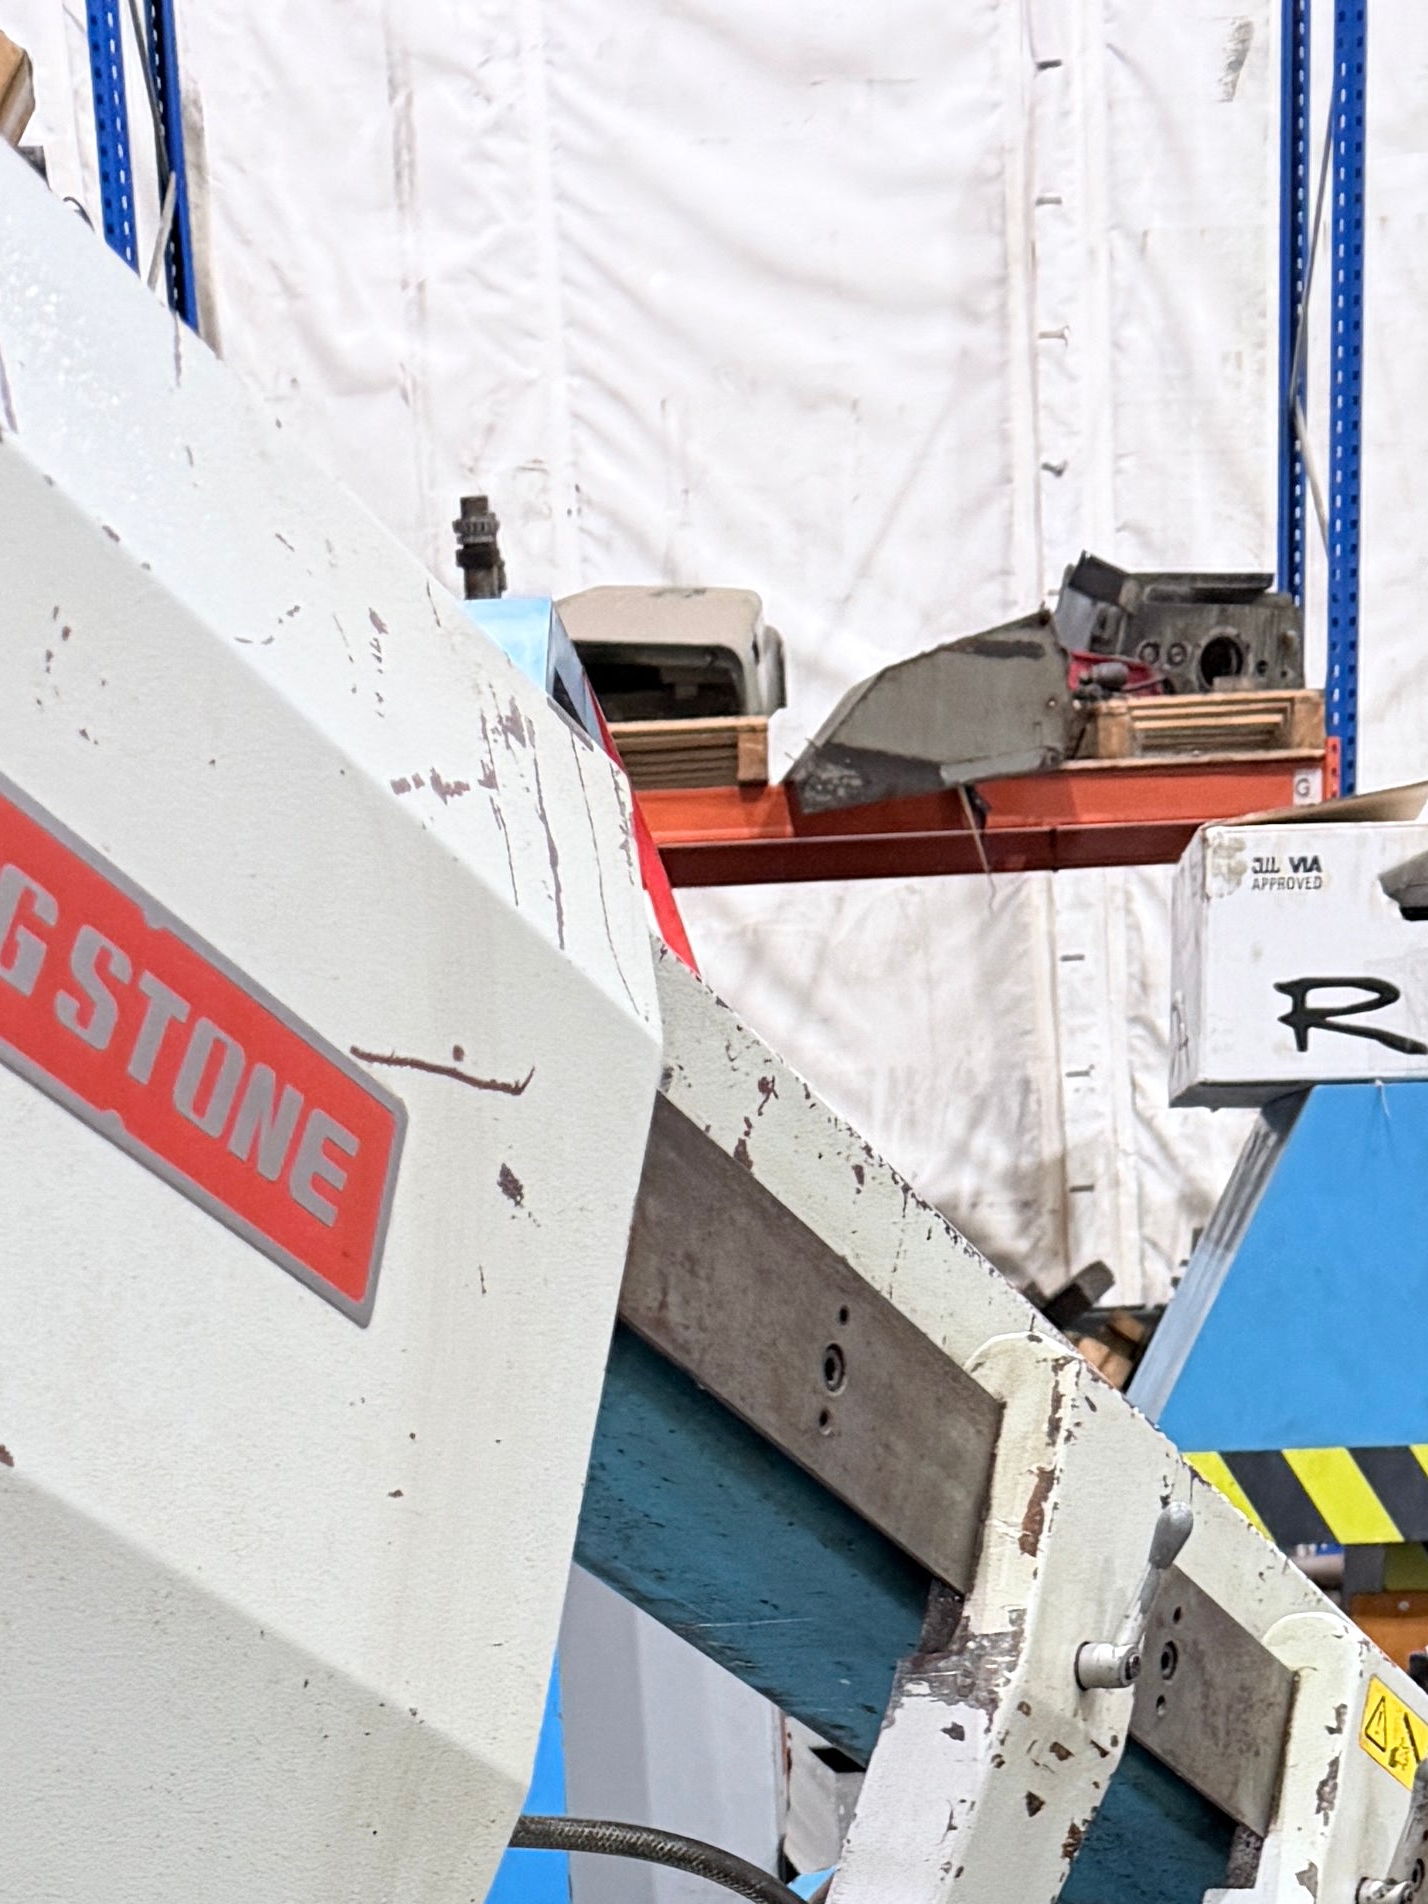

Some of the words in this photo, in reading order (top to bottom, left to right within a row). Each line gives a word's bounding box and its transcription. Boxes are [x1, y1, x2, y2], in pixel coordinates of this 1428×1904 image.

[1288, 855, 1323, 873] VIA
[1252, 876, 1322, 890] APPROVED
[56, 925, 360, 1227] STONE
